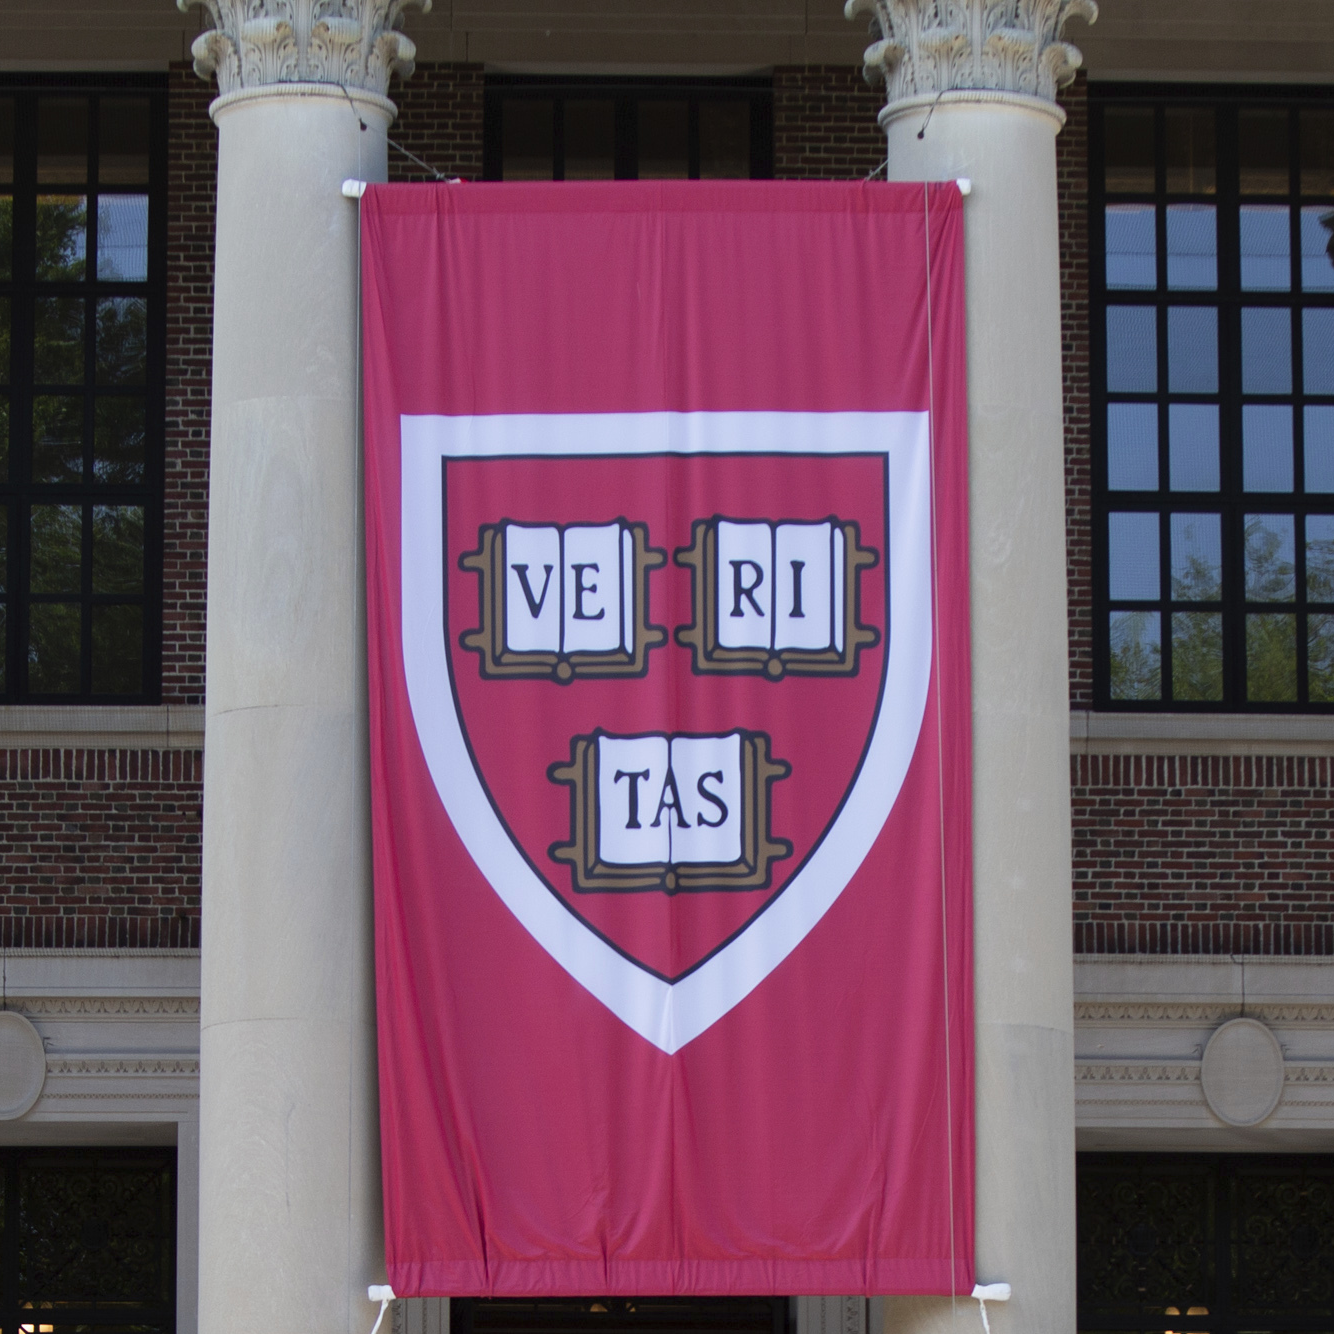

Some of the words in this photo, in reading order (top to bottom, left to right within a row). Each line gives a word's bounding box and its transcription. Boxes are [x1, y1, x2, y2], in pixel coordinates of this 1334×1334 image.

[510, 561, 605, 621] VE
[728, 559, 807, 619] RI
[613, 769, 730, 830] TAS
